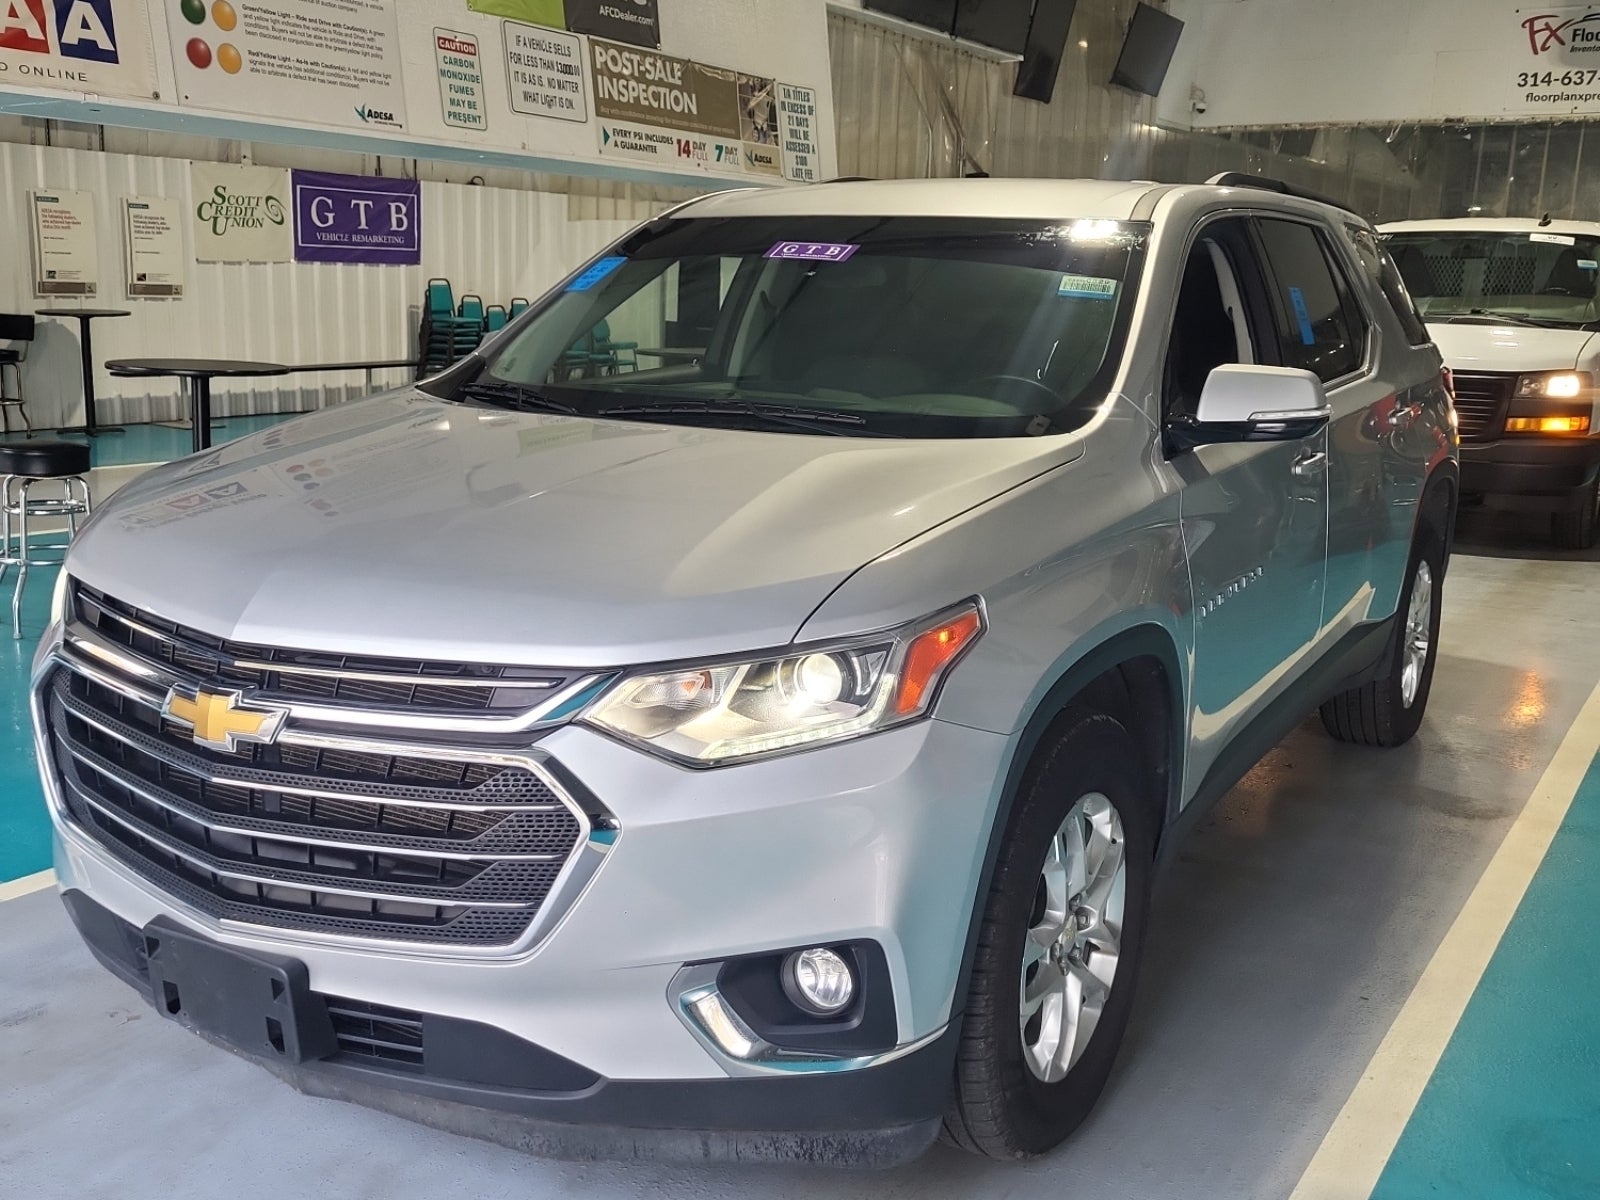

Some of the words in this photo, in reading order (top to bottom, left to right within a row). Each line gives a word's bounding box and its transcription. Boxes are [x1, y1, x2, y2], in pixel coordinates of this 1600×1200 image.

[600, 5, 653, 25] AFCDealer.com
[440, 39, 475, 54] CAUTION
[516, 35, 521, 46] IF
[523, 36, 527, 48] A
[528, 37, 552, 54] VEHICLE
[554, 42, 571, 57] SELLS
[443, 56, 474, 69] CARBON
[510, 52, 522, 64] FOR
[524, 54, 538, 68] LESS
[539, 58, 555, 72] THAN
[595, 46, 682, 85] POST-SALE
[18, 64, 88, 82] ONLINE
[440, 68, 480, 84] MONOXIDE
[514, 70, 519, 82] IT
[521, 72, 527, 84] IS
[528, 73, 536, 86] AS
[547, 76, 556, 89] NO
[557, 78, 579, 93] MATTER
[449, 84, 474, 96] FUMES
[597, 75, 697, 114] INSPECTION
[792, 90, 810, 102] TITLES
[450, 98, 465, 108] MAY
[468, 100, 477, 110] BE
[523, 90, 539, 104] WHAT
[540, 93, 557, 108] LIGHT
[559, 97, 564, 108] IS
[367, 109, 394, 121] ADESA
[781, 100, 786, 111] IN
[787, 102, 806, 115] EXCESS
[808, 105, 814, 116] OF
[448, 110, 481, 124] PRESENT
[796, 116, 809, 128] DAYS
[612, 128, 631, 139] EVERY
[633, 131, 643, 140] PSI
[645, 133, 673, 145] INCLUDES
[789, 128, 801, 140] WILL
[614, 140, 619, 148] A
[620, 141, 657, 154] GUARANTEE
[676, 138, 691, 158] 14
[692, 141, 707, 152] DAY
[715, 144, 723, 162] 7
[725, 146, 738, 156] DAY
[786, 141, 810, 154] ASSESSED
[812, 144, 816, 154] A
[692, 151, 708, 161] FULL
[724, 155, 739, 166] FULL
[792, 167, 803, 179] LATE
[804, 168, 813, 179] FEE
[316, 232, 349, 242] VEHICLE
[352, 233, 404, 244] REMARKETING
